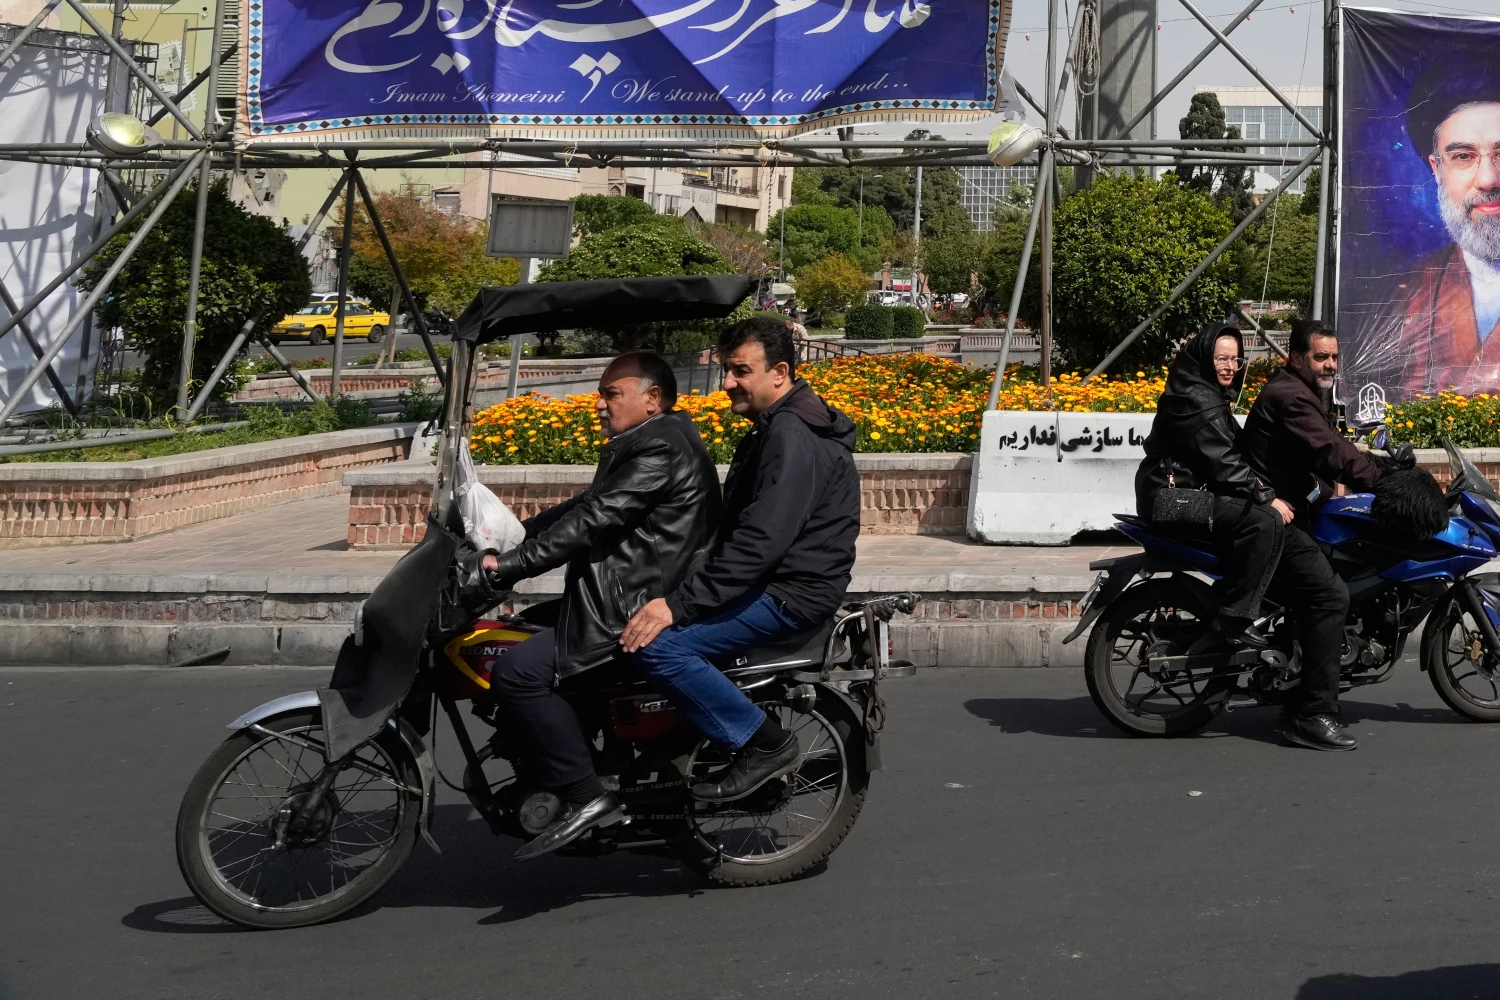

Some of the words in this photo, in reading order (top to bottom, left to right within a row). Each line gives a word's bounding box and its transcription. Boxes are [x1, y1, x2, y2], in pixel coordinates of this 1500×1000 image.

[369, 81, 448, 105] Imam
[453, 80, 566, 105] Khomeini
[611, 75, 677, 105] We
[771, 84, 797, 104] to
[800, 82, 836, 105] the
[999, 425, 1057, 451] نداریم
[1060, 426, 1123, 452] سازشی
[461, 646, 509, 656] HOND
